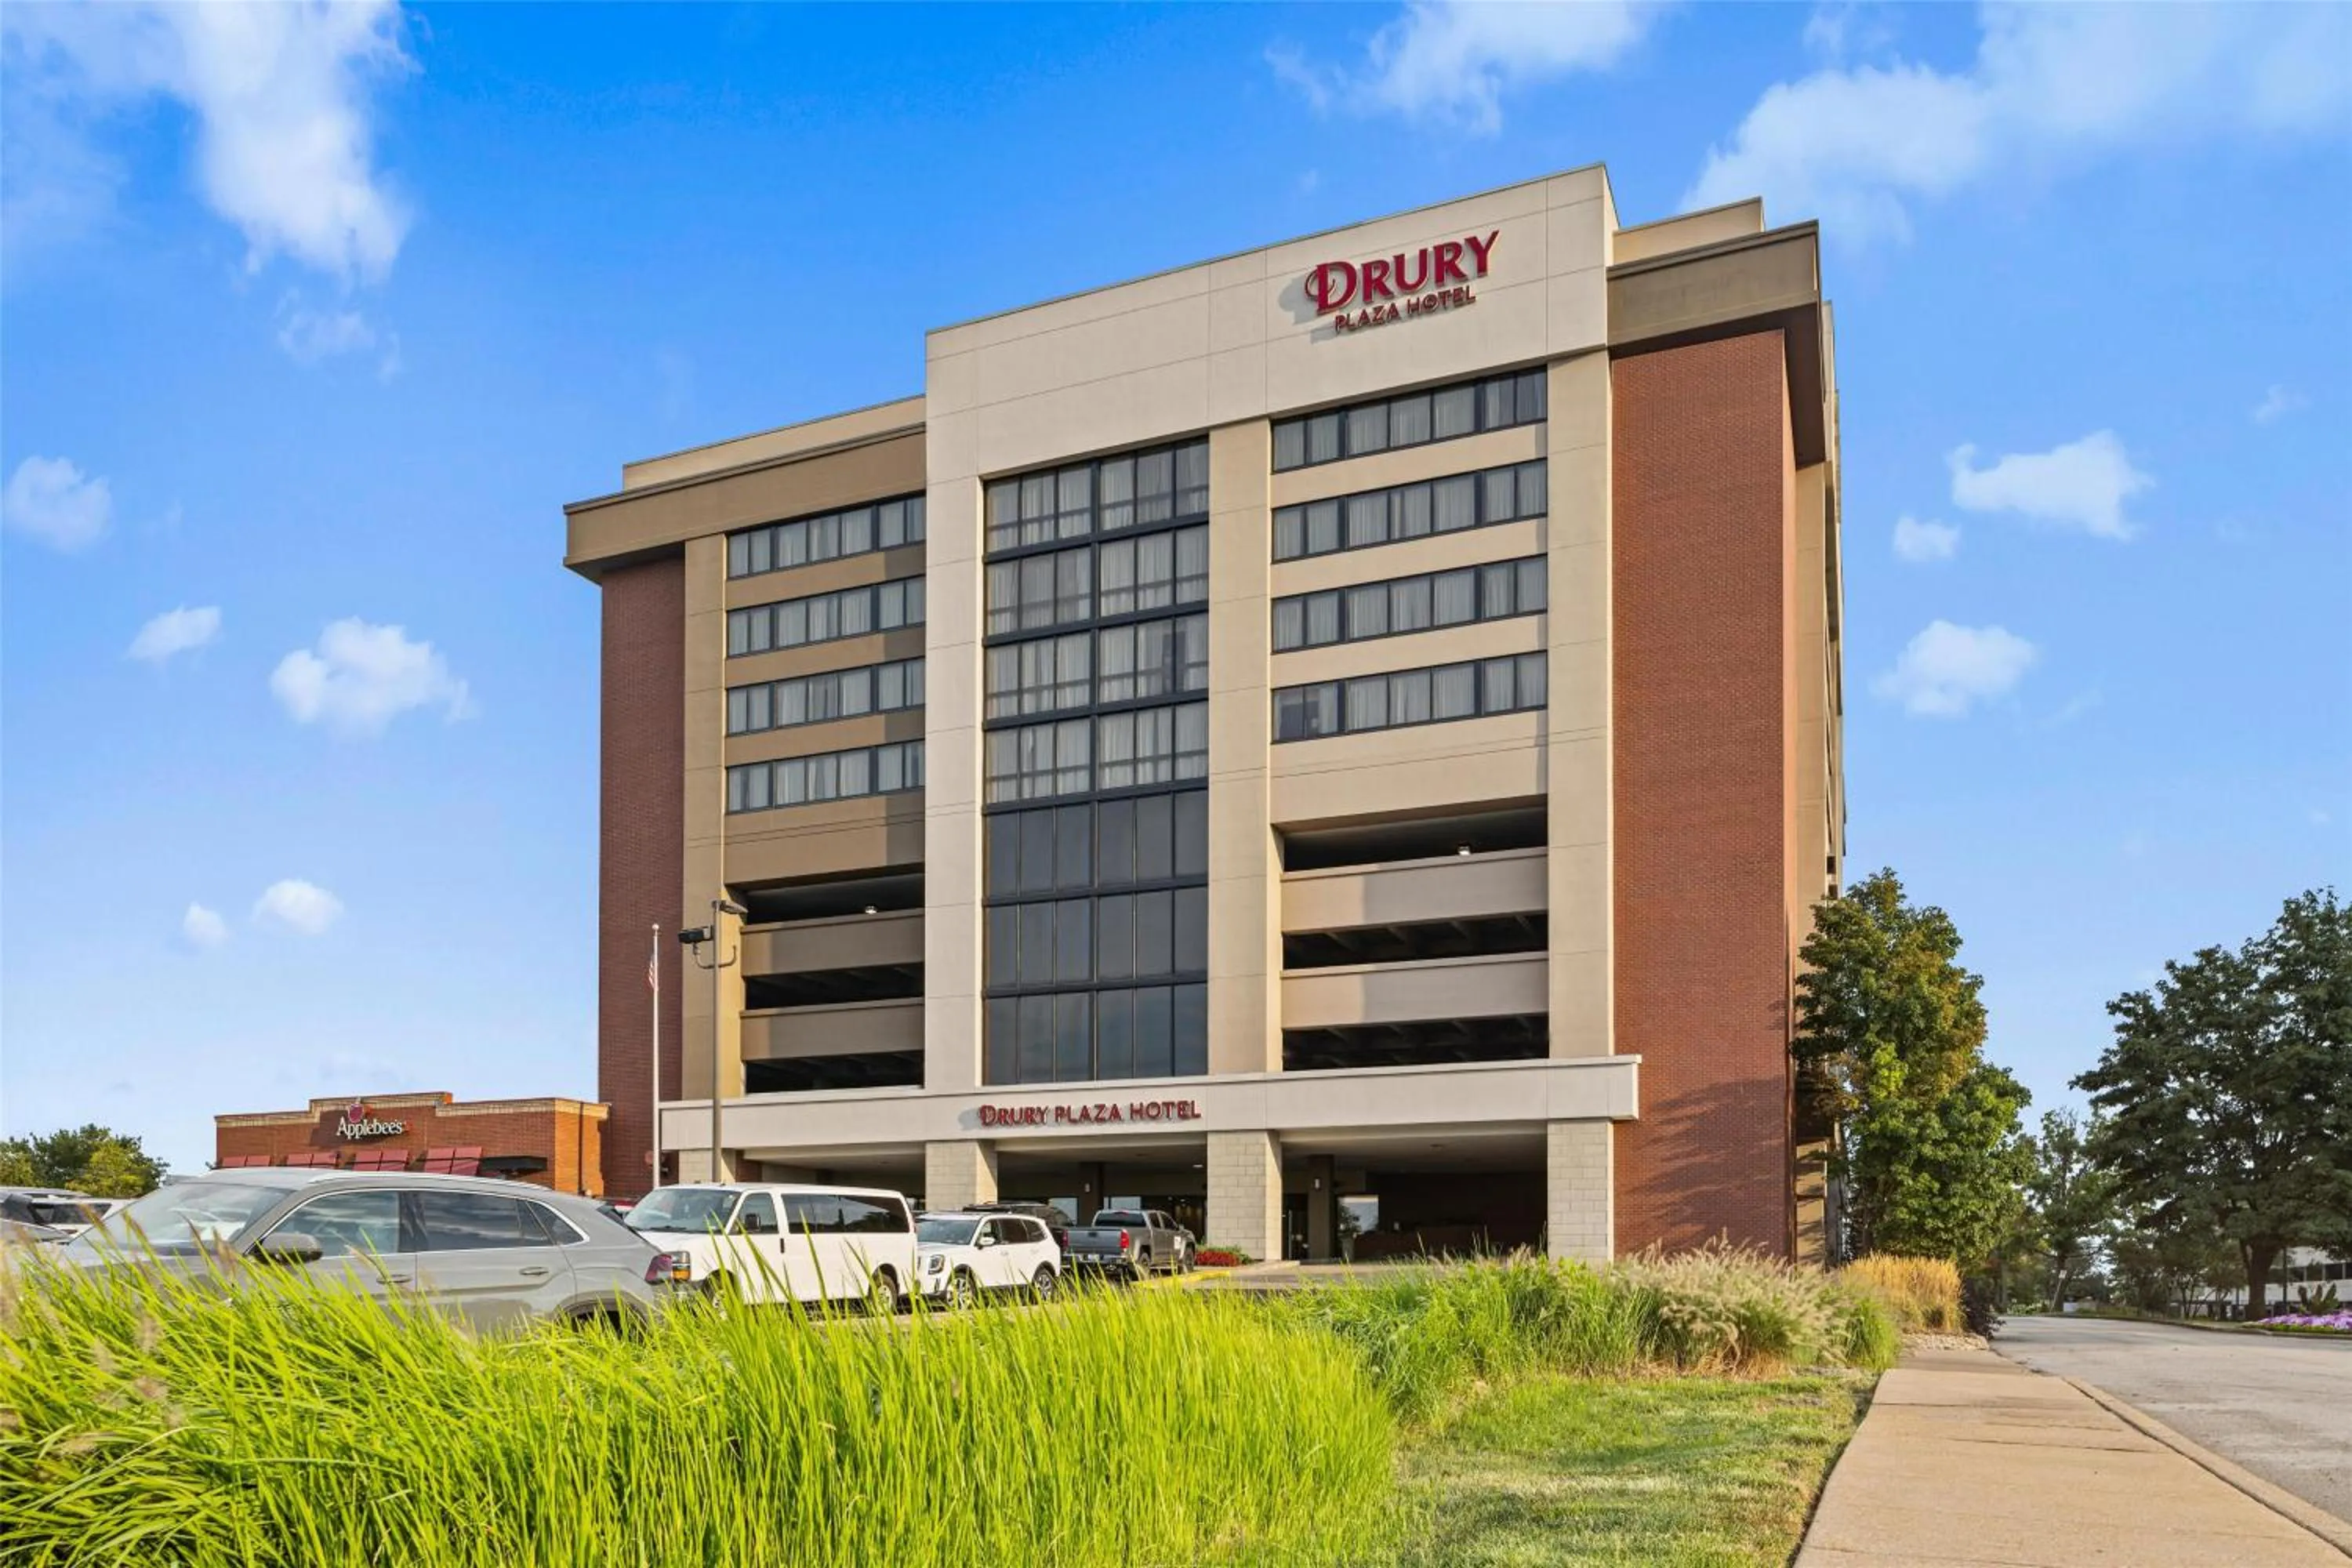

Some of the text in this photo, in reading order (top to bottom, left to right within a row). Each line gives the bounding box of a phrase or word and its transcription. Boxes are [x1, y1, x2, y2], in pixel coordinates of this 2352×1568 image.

[1305, 230, 1499, 315] DRURY
[1334, 285, 1476, 334] PLAZA HOTEL
[336, 1116, 402, 1139] Applebee's
[979, 1100, 1201, 1127] DRURY PLAZA HOTEL
